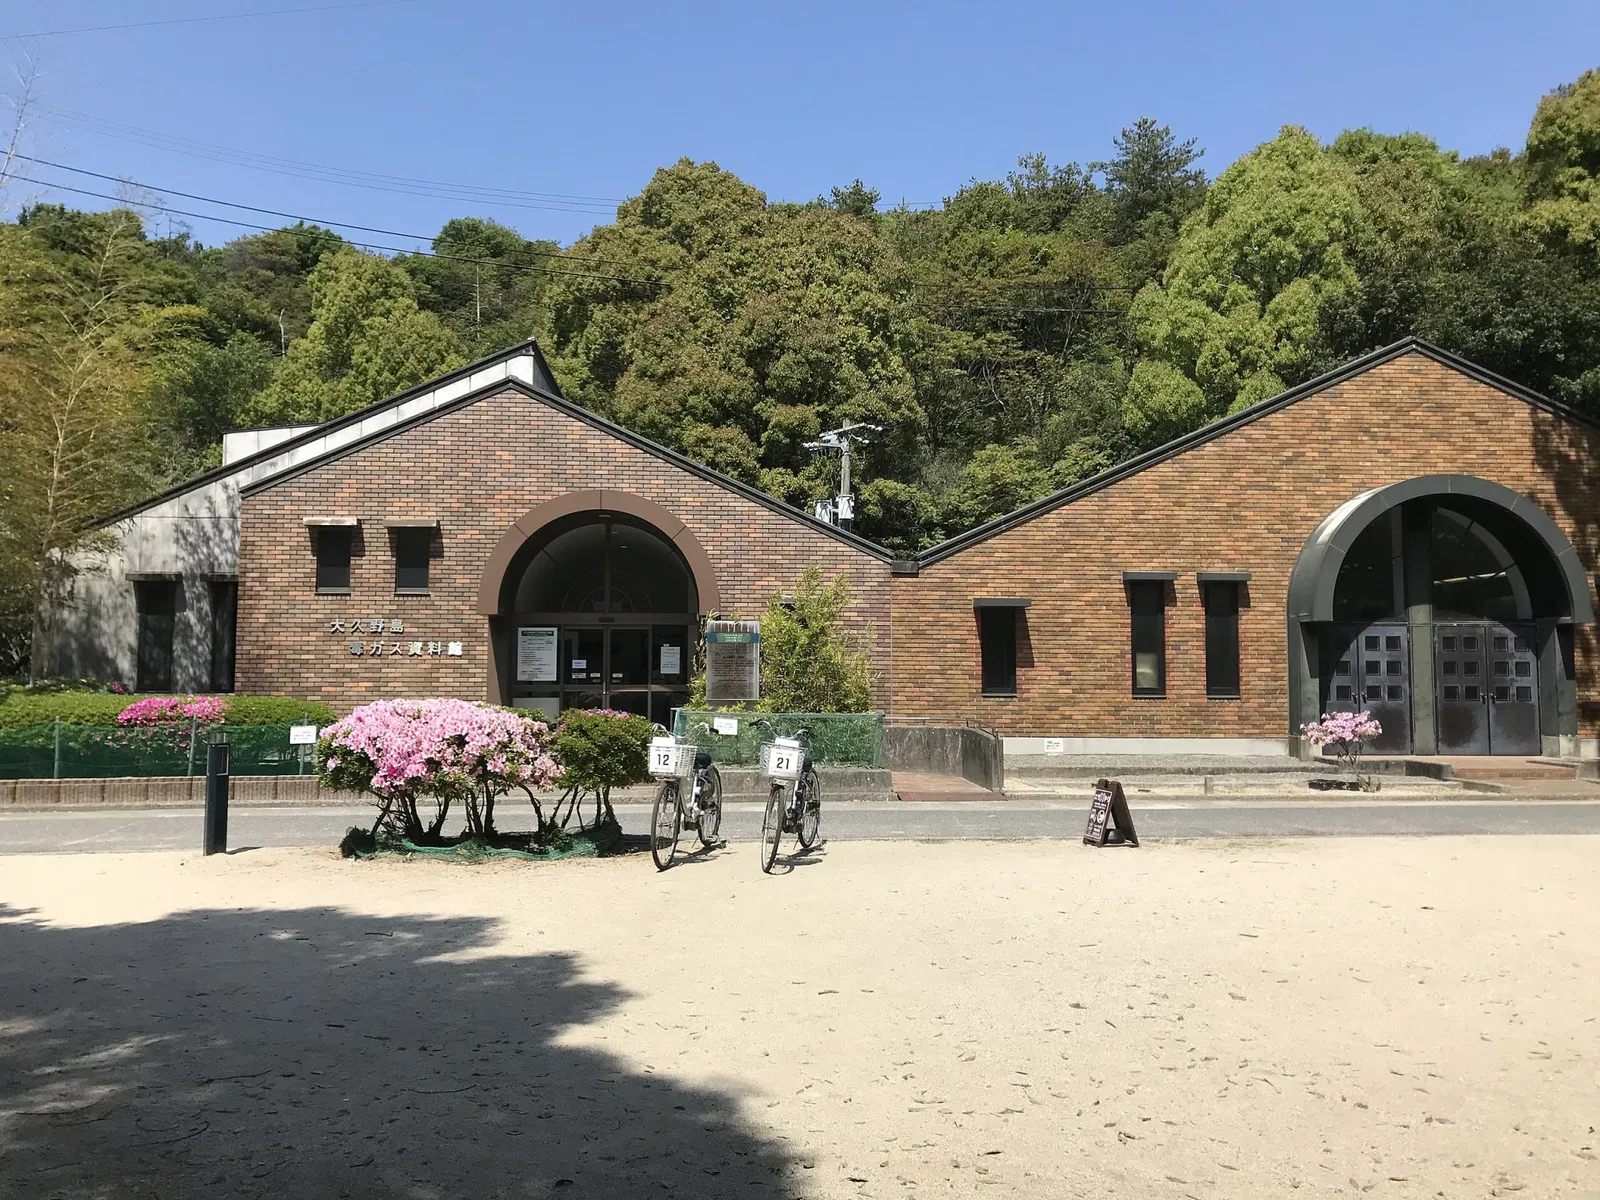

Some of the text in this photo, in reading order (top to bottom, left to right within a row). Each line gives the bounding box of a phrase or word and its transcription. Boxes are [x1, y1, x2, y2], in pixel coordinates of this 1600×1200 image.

[330, 618, 404, 633] 大久野島
[349, 640, 463, 656] 毒ガス資料館
[657, 753, 670, 766] 12
[776, 757, 790, 770] 21
